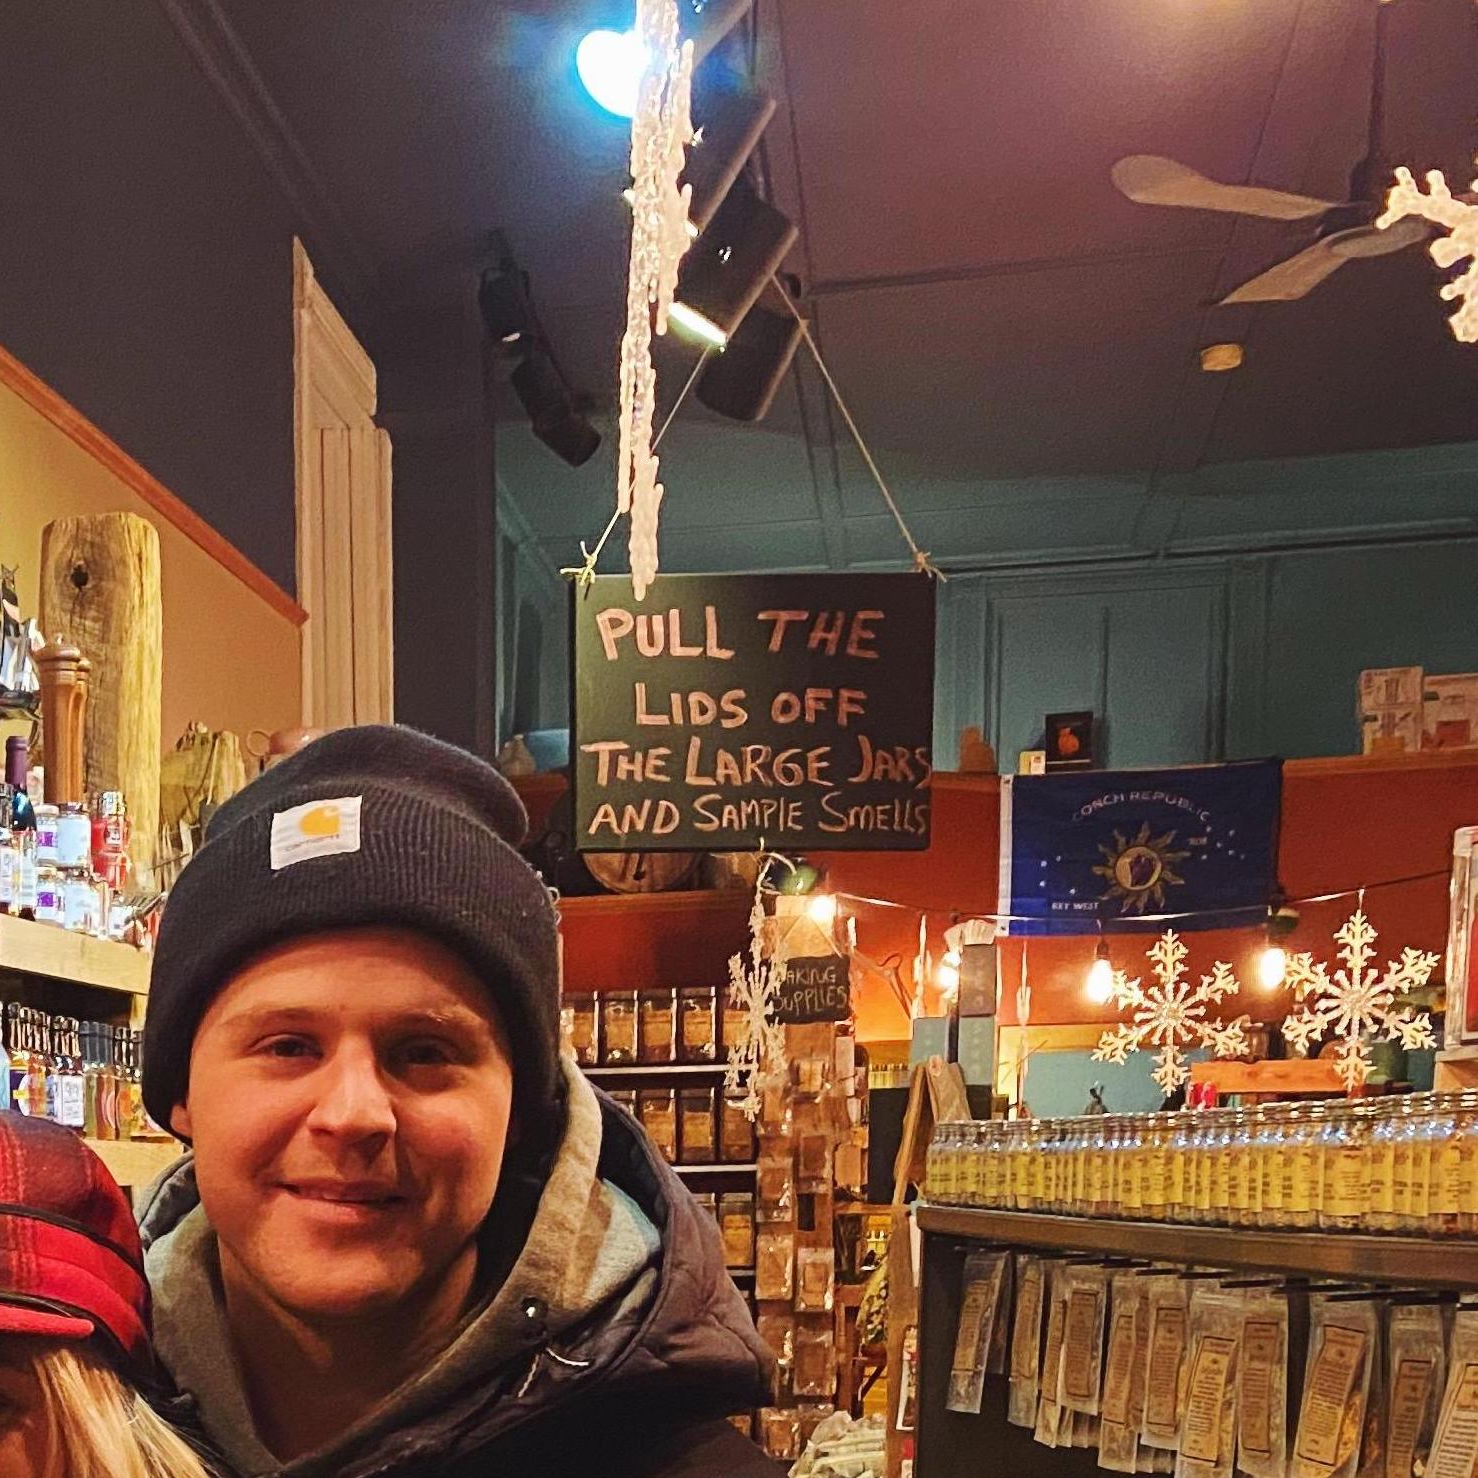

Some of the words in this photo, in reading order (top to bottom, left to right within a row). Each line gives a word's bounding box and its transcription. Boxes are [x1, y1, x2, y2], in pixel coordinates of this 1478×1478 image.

[595, 605, 736, 661] PULL
[757, 609, 885, 660] THE
[634, 681, 749, 729] LIDS
[771, 687, 868, 727] OFF
[580, 741, 672, 787] THE
[685, 735, 836, 787] LARGE
[847, 734, 933, 791] JARS
[588, 798, 681, 836] AND
[1073, 900, 1099, 912] WEST
[786, 965, 837, 985] AKING
